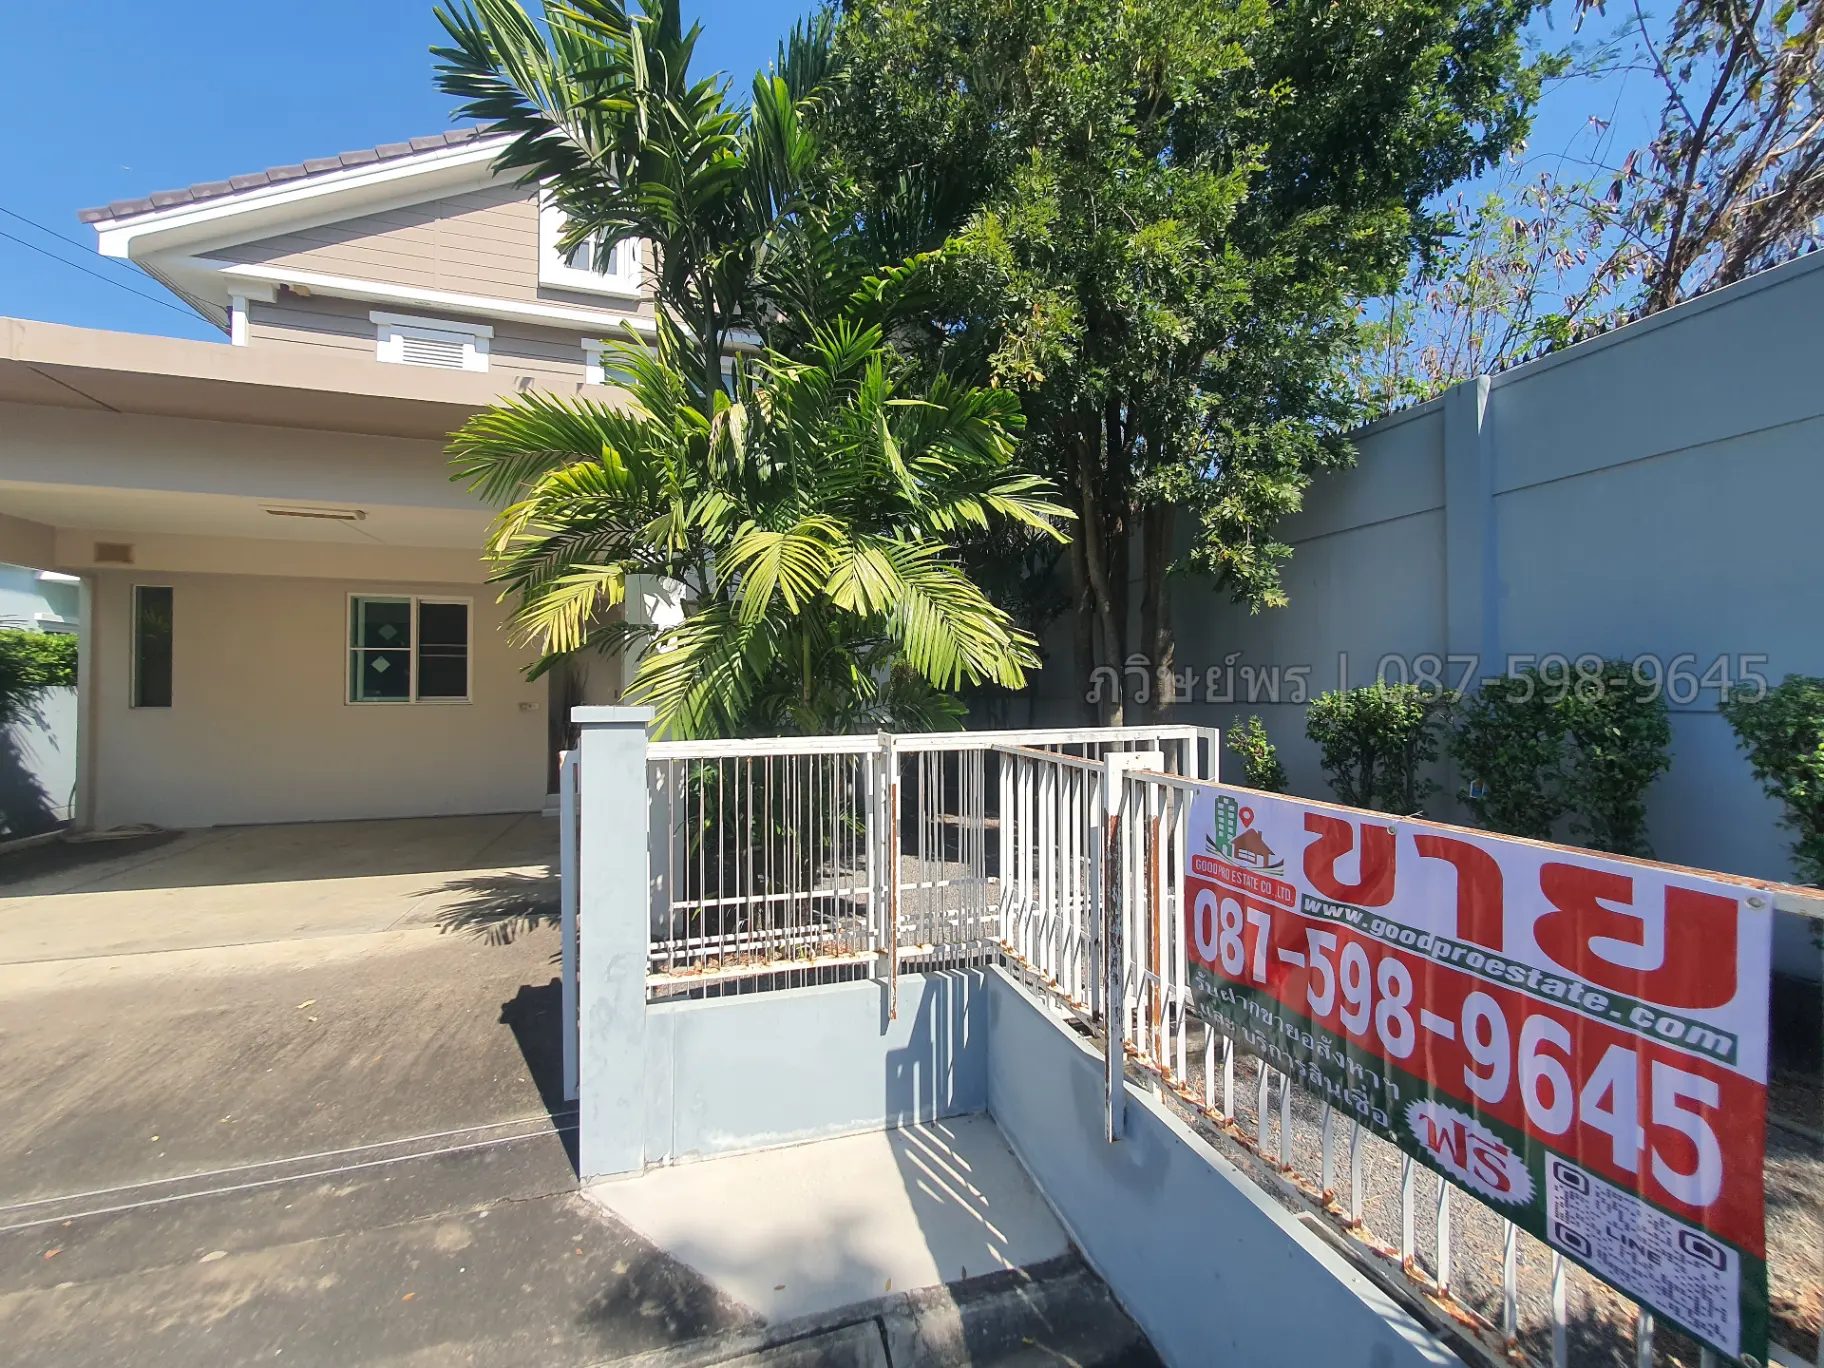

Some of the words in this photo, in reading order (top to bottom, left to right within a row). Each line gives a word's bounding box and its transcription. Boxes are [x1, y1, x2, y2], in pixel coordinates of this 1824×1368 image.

[1231, 870, 1259, 891] ESTATE
[1303, 811, 1739, 1010] ขาย
[1304, 897, 1735, 1057] www.goodproestate.com
[1193, 888, 1725, 1207] 087-598-9645
[1419, 1112, 1512, 1193] ฟรี
[1606, 1226, 1663, 1267] LINE
